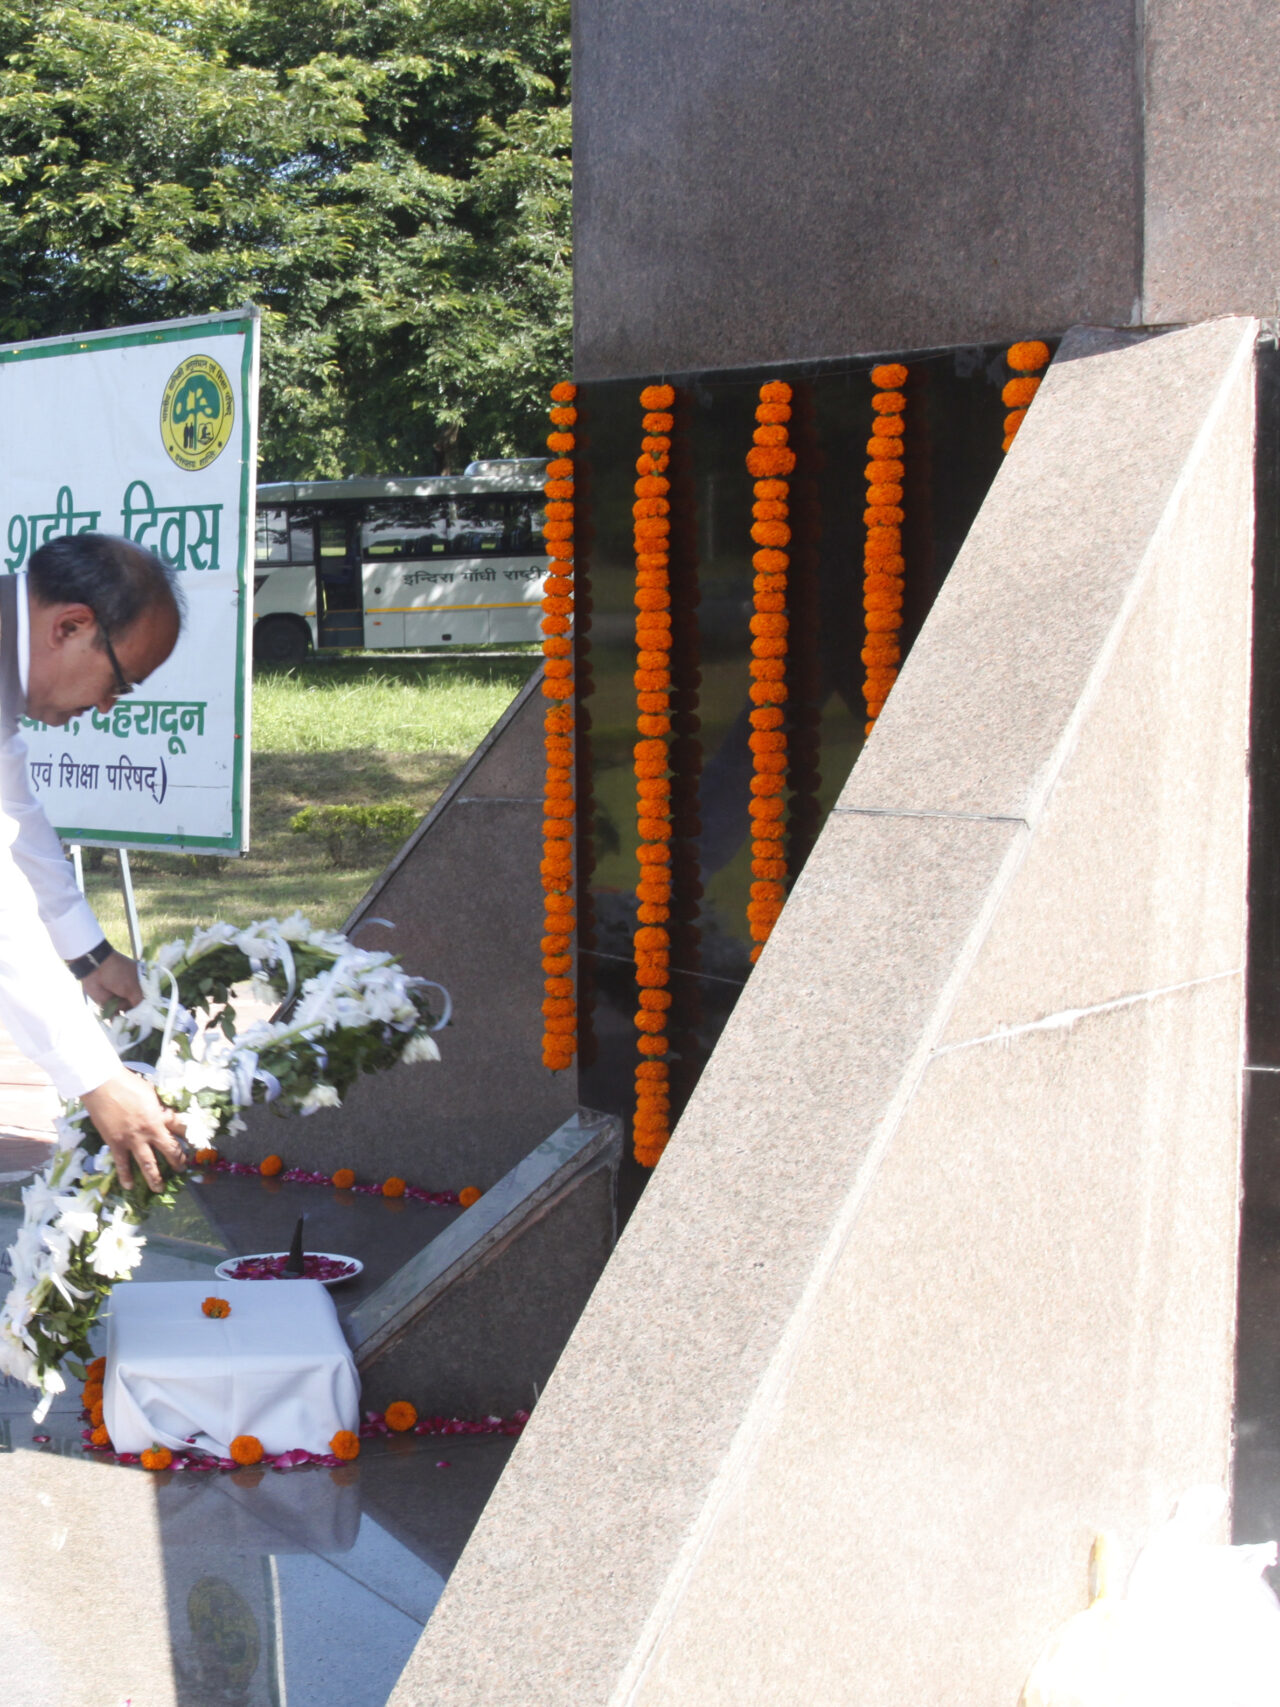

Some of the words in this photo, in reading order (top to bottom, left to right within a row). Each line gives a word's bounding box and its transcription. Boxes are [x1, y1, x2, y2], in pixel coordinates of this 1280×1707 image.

[4, 485, 102, 574] शी
[91, 700, 208, 755] दहरादून
[30, 753, 53, 792] एवं
[59, 752, 100, 790] शिक्षा
